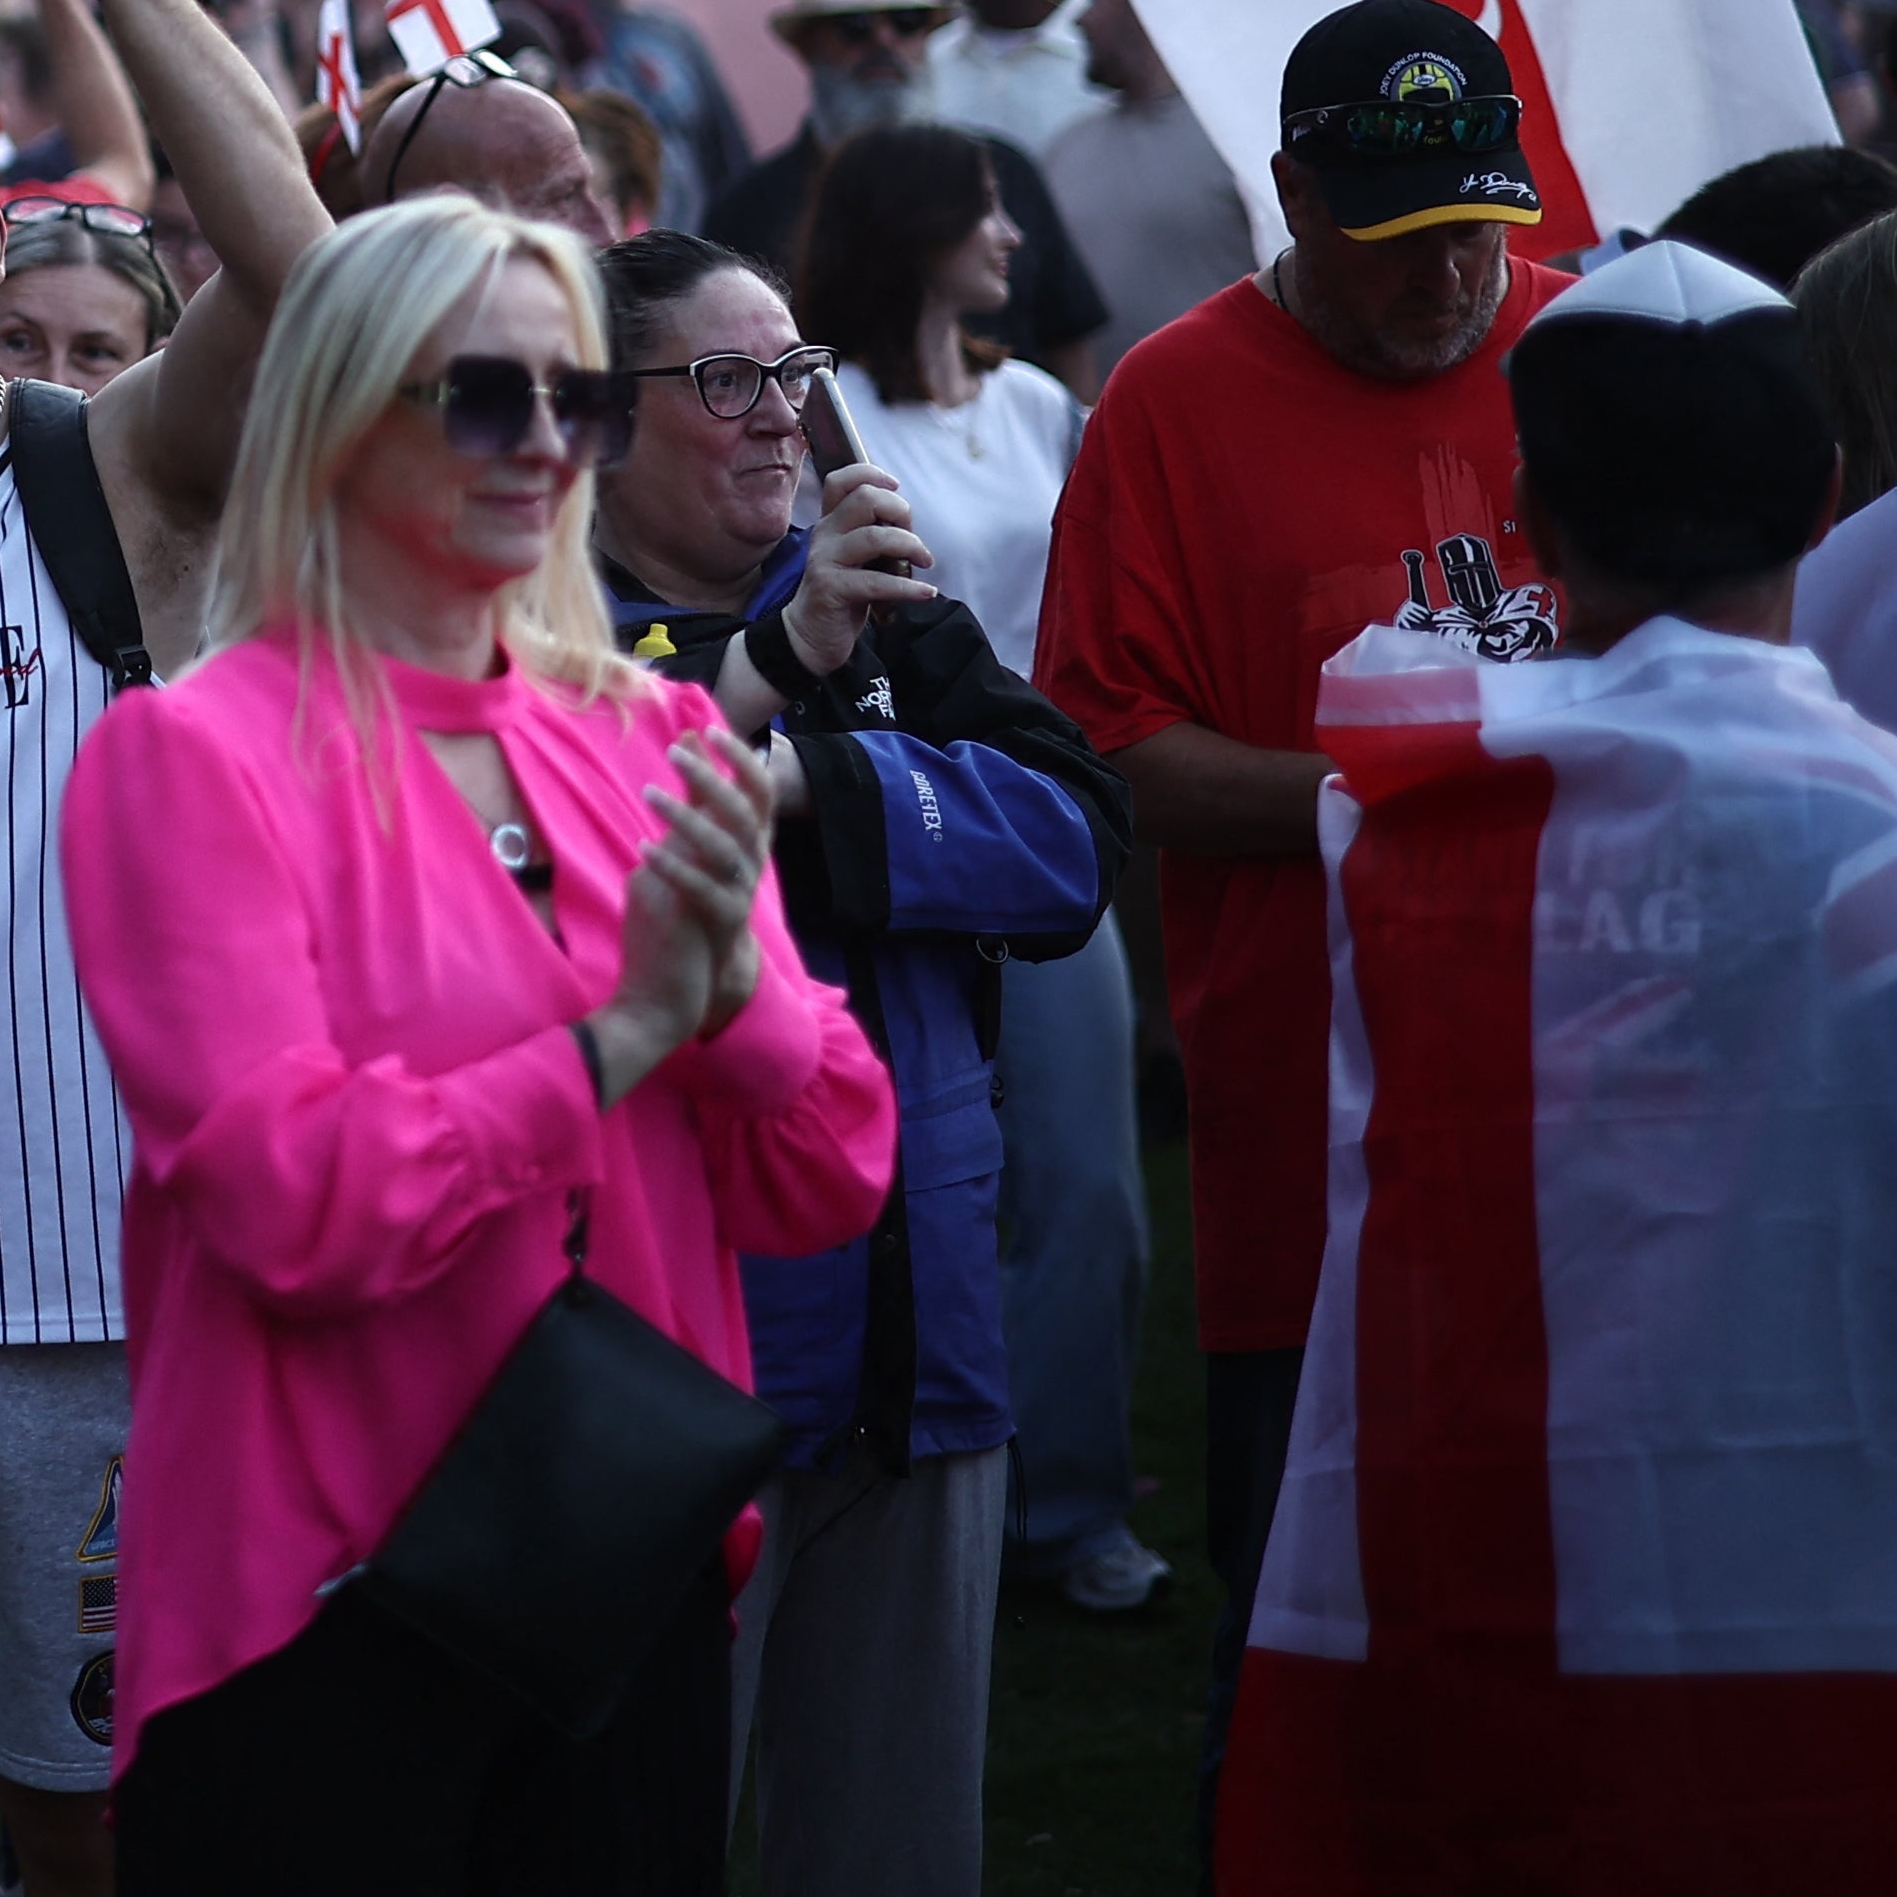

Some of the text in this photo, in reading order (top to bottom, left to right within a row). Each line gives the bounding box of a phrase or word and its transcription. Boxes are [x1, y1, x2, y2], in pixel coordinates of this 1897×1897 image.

[1379, 75, 1391, 96] JOEY
[1389, 52, 1421, 76] DUNLOP
[1422, 51, 1468, 86] FOUNDATION
